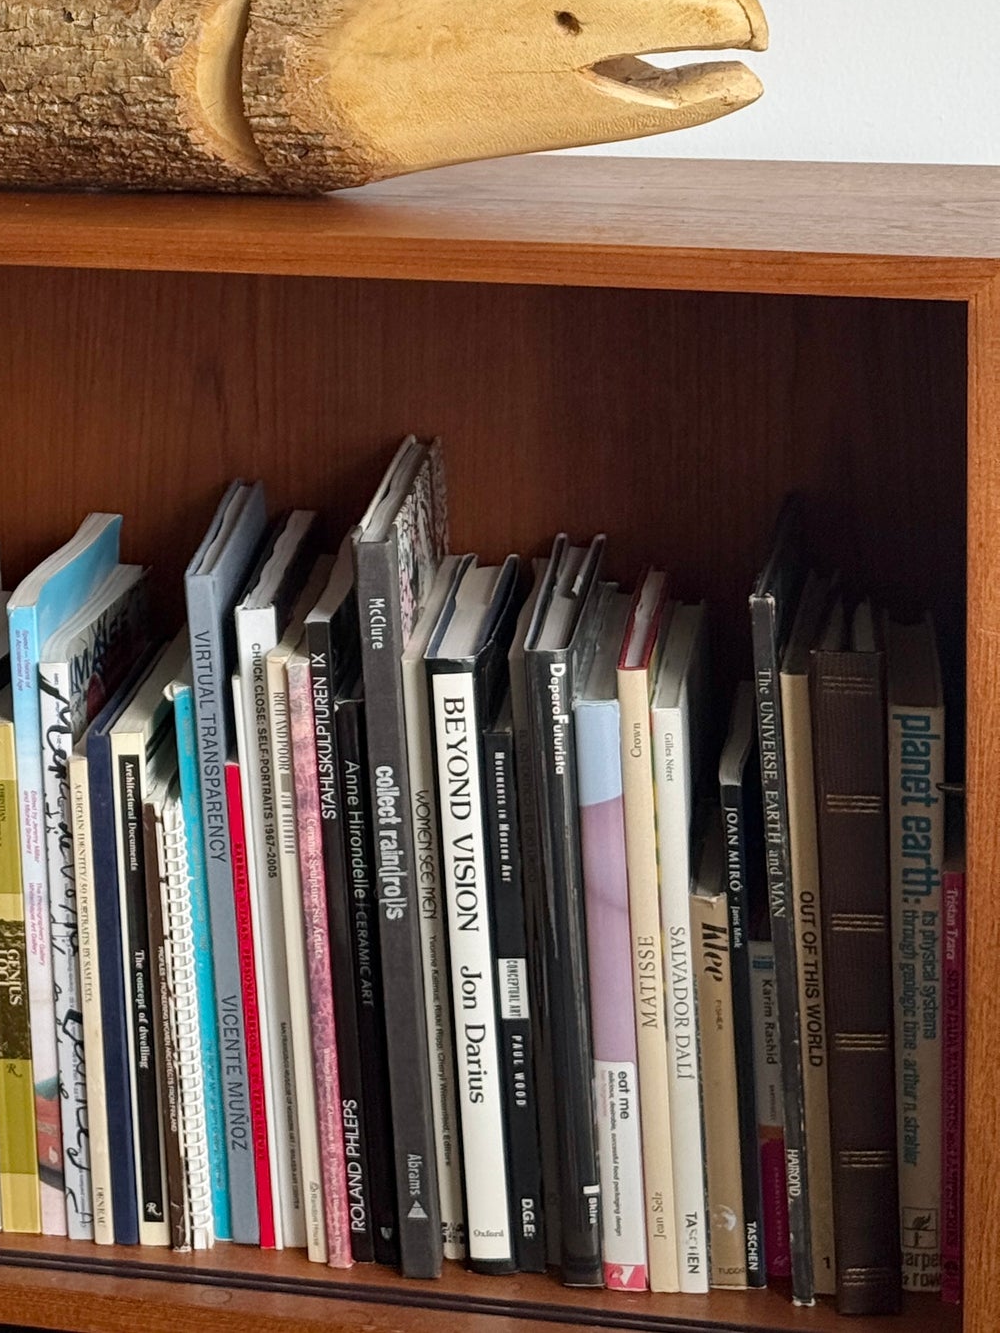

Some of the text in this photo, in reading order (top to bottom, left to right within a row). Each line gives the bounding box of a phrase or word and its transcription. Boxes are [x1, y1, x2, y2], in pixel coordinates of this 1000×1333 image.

[193, 629, 218, 710] VIRTUAL
[367, 597, 400, 825] McClure collect
[250, 642, 275, 821] CHUCK CLOSE: SELF-PORTRAITS
[276, 739, 292, 772] POOR
[310, 651, 337, 821] STAHLSKULPTUREN IX
[548, 662, 570, 776] DeperoFuturista
[630, 722, 643, 758] Crown
[199, 713, 228, 864] TRANSPARENCY
[757, 667, 788, 919] The UNIVERSE, EARTH and MAN
[892, 713, 944, 905] planet earth:
[305, 817, 320, 858] Ceramic
[344, 759, 375, 1007] Anne Hirondelle CERAMIC ART
[415, 788, 439, 921] WOMEN SEE MEN
[123, 761, 152, 1070] Architectural Documents The concept of dwelling
[442, 696, 490, 1106] BEYOND VISION Jon Darius
[663, 732, 697, 1081] Gilles Néret SALVADOR DALÍ
[944, 887, 960, 928] Tristan
[944, 928, 960, 962] Tzara
[7, 948, 23, 1006] GENIUS
[505, 958, 524, 1018] CONCEPTUAL ART
[636, 934, 660, 1029] MATISSE
[700, 921, 731, 983] Klee
[799, 889, 824, 1068] OUT OF THIS WORLD
[918, 910, 940, 1041] its physical systems
[220, 994, 244, 1076] VICENTE
[723, 806, 759, 1272] JOAN MIRÓ Janis Mink TASCHEN
[760, 977, 779, 1066] Karim Rashid
[898, 908, 922, 1168] through geologic time arthur strahler
[226, 1081, 251, 1152] MUÑOZ
[510, 1034, 529, 1107] PAUL WOOD
[617, 1070, 632, 1121] eat me
[341, 1098, 367, 1232] ROLAND PHLEPS
[406, 1152, 424, 1196] Abrams
[587, 1196, 600, 1225] Skira
[473, 1227, 505, 1238] Oxford
[650, 1190, 667, 1240] Jean Selz
